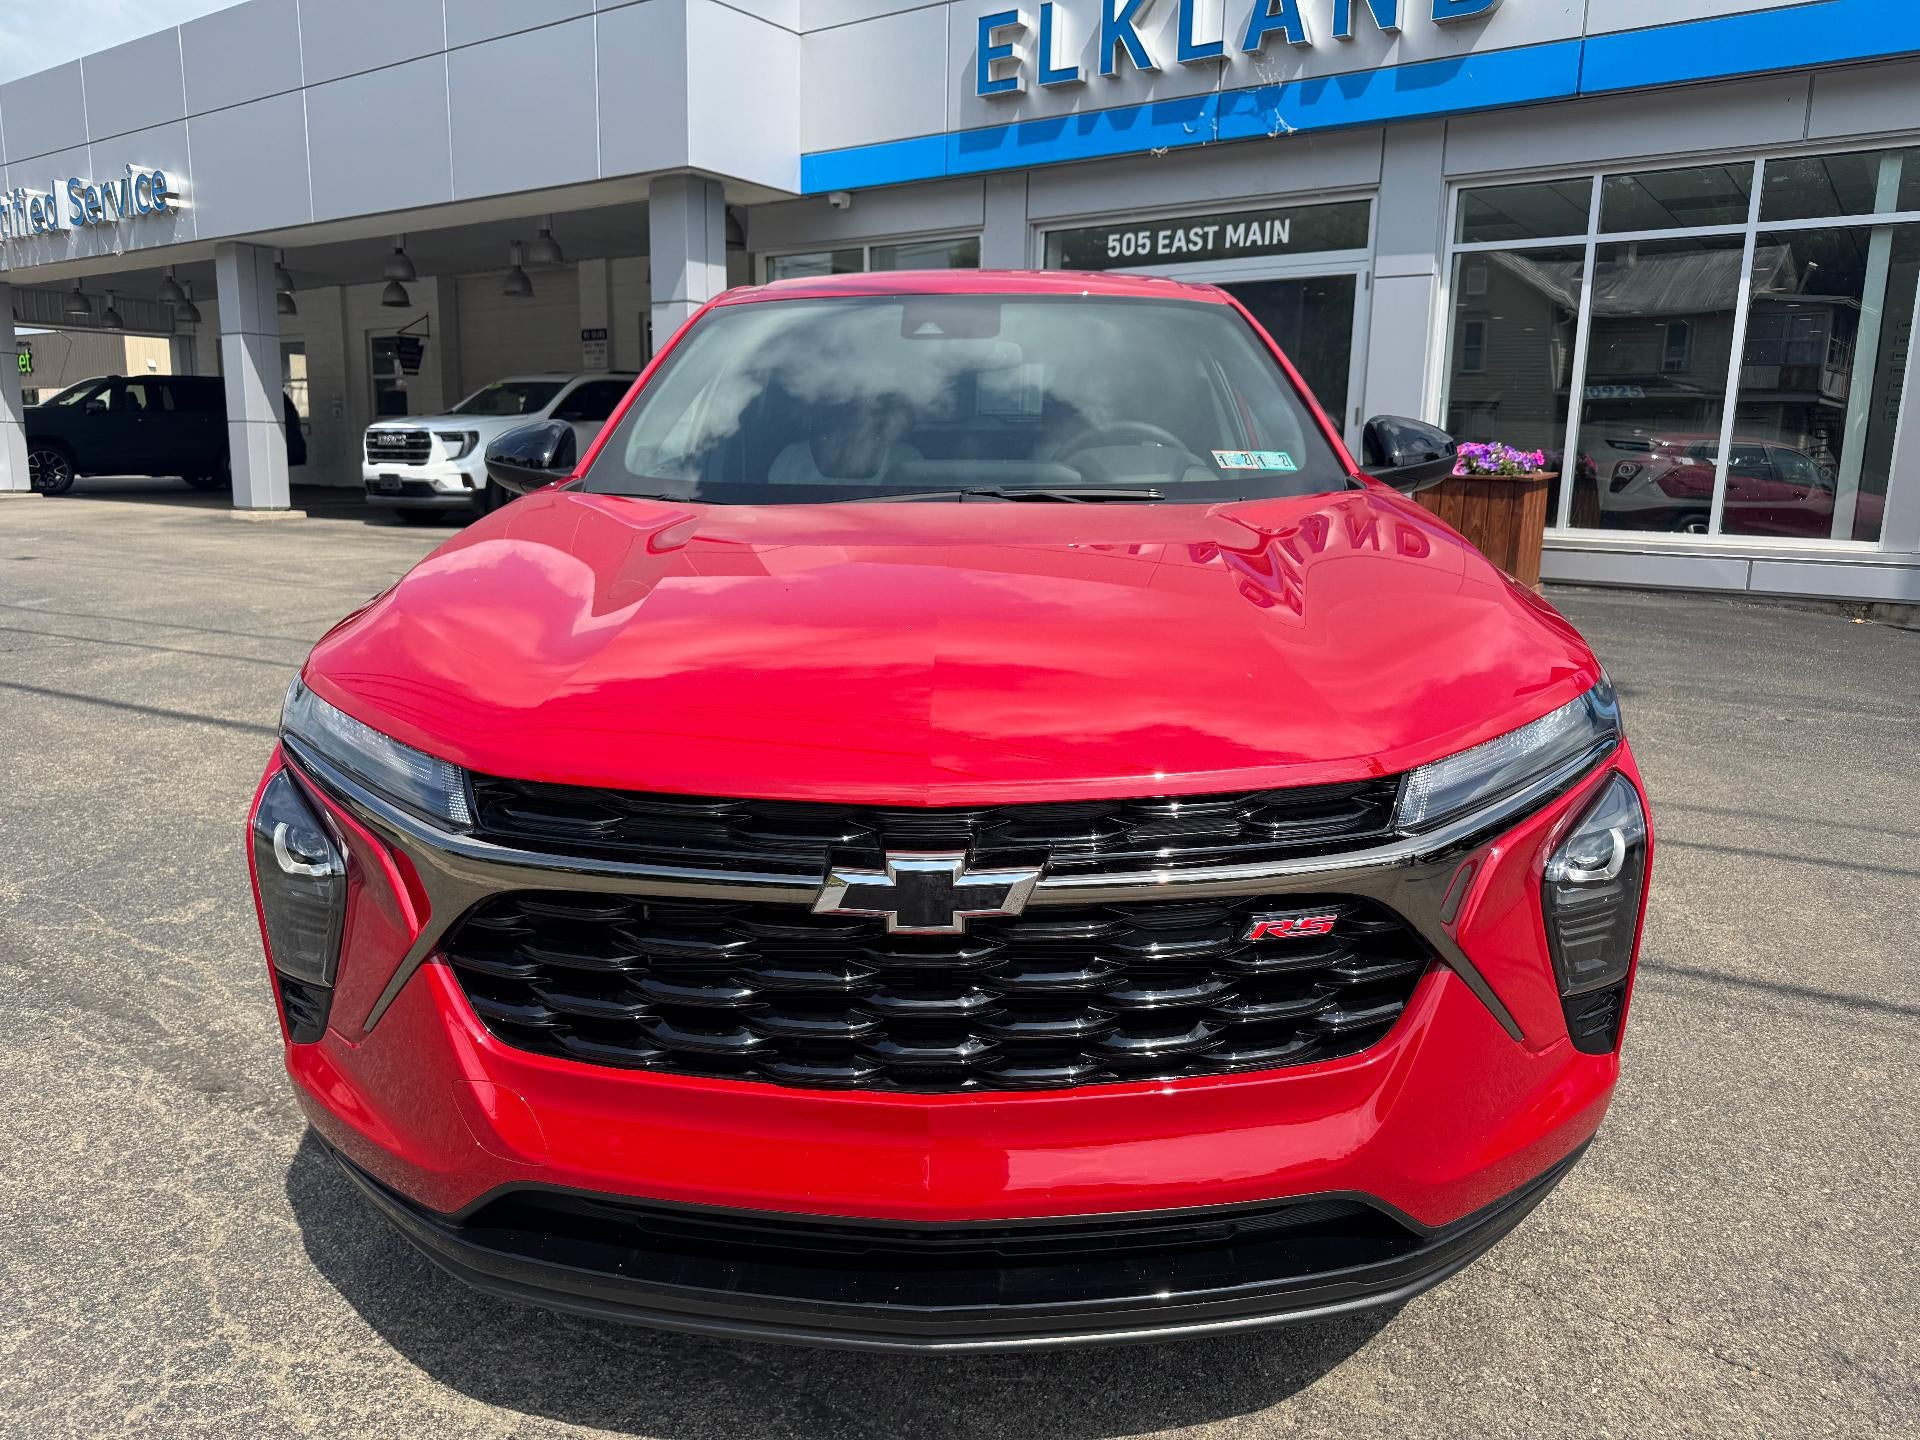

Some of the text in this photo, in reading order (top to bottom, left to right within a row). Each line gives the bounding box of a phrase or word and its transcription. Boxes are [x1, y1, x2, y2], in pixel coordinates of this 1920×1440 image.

[976, 0, 1500, 98] ELKLA
[67, 163, 168, 226] Service
[1107, 218, 1291, 258] 505 EAST MAIN
[18, 349, 31, 373] et
[1244, 913, 1338, 941] RS
